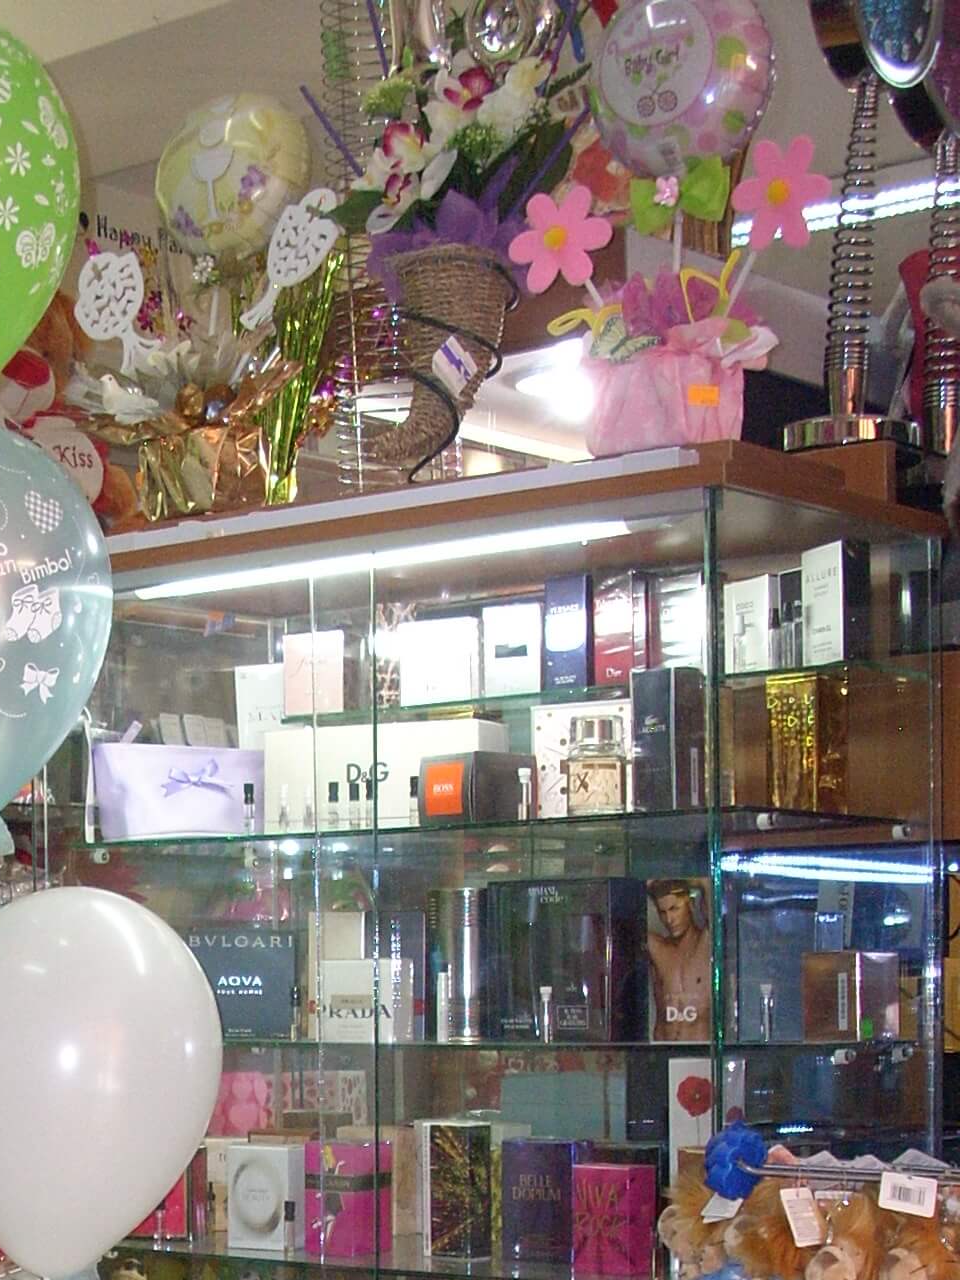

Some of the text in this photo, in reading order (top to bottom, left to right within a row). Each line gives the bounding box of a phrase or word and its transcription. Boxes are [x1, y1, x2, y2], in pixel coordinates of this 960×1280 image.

[52, 444, 93, 469] Kiss
[806, 566, 837, 584] ALLURE
[346, 761, 390, 784] D&G
[189, 935, 293, 948] BVLGARI
[665, 1006, 698, 1023] D&G
[519, 1174, 552, 1187] BELLE
